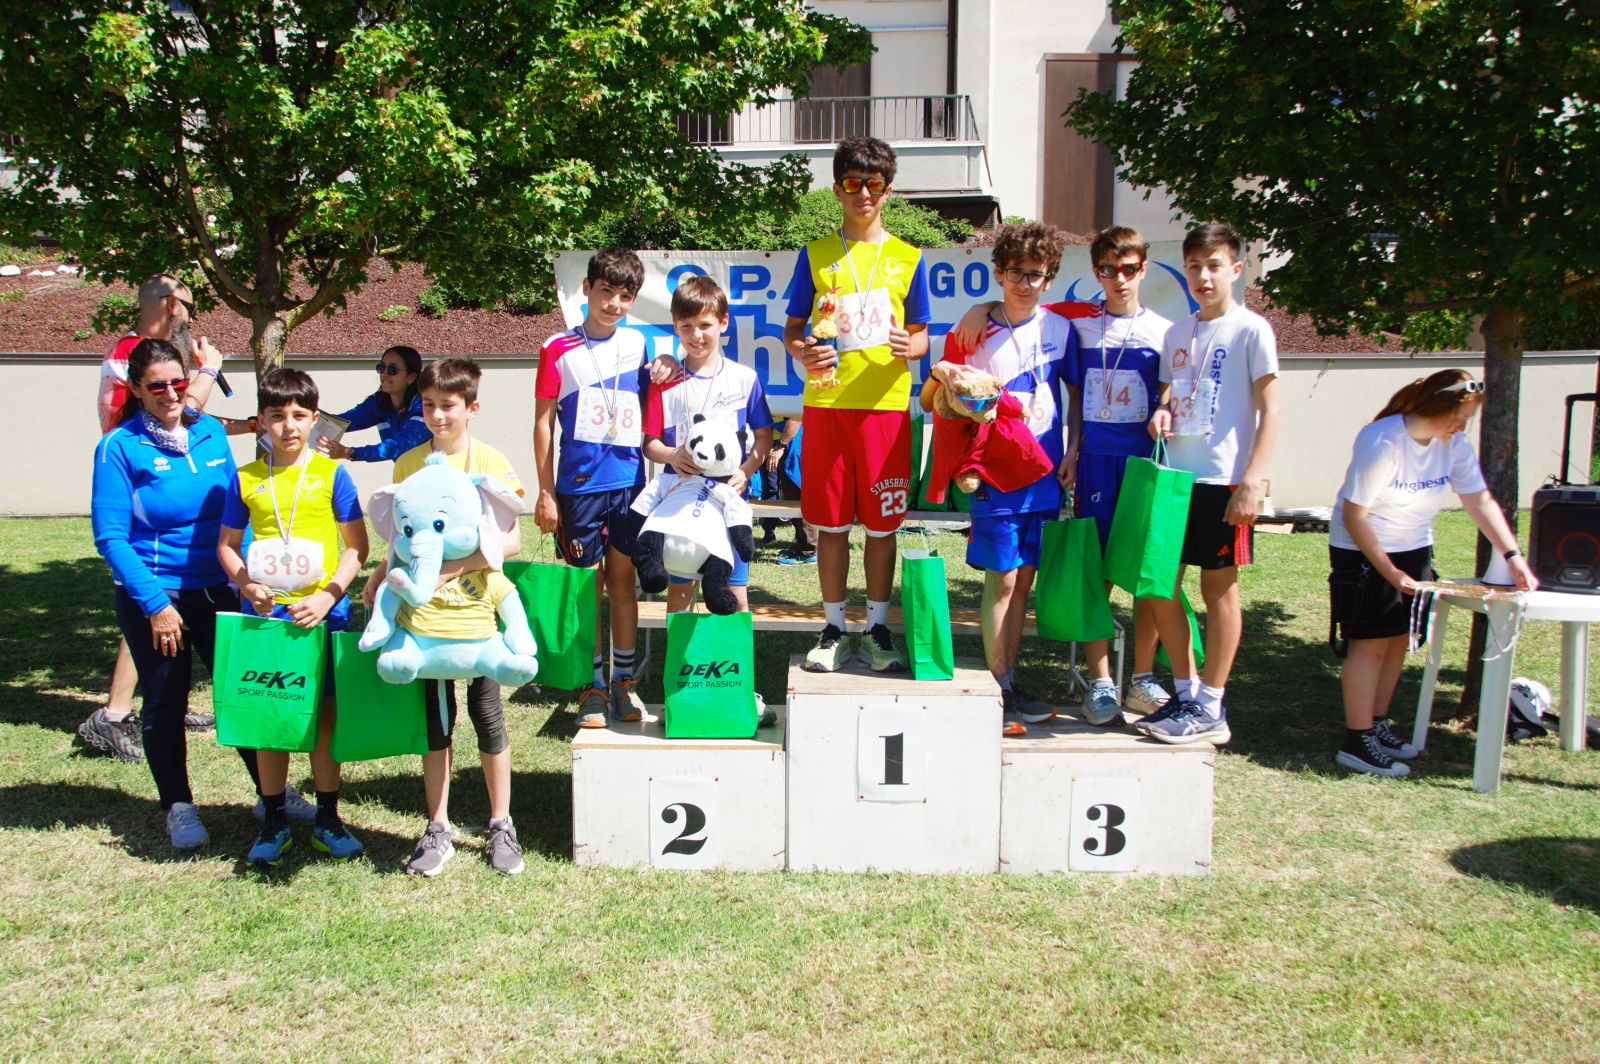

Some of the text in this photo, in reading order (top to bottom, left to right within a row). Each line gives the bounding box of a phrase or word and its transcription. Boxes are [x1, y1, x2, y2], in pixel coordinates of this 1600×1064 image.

[880, 489, 907, 518] 23
[240, 669, 306, 690] DEKA
[678, 660, 740, 679] DEKA
[237, 687, 306, 701] SPORT PASSION
[677, 680, 742, 689] SPORT PASSION
[878, 732, 909, 785] 1
[661, 802, 708, 856] 2
[1083, 803, 1126, 857] 3
